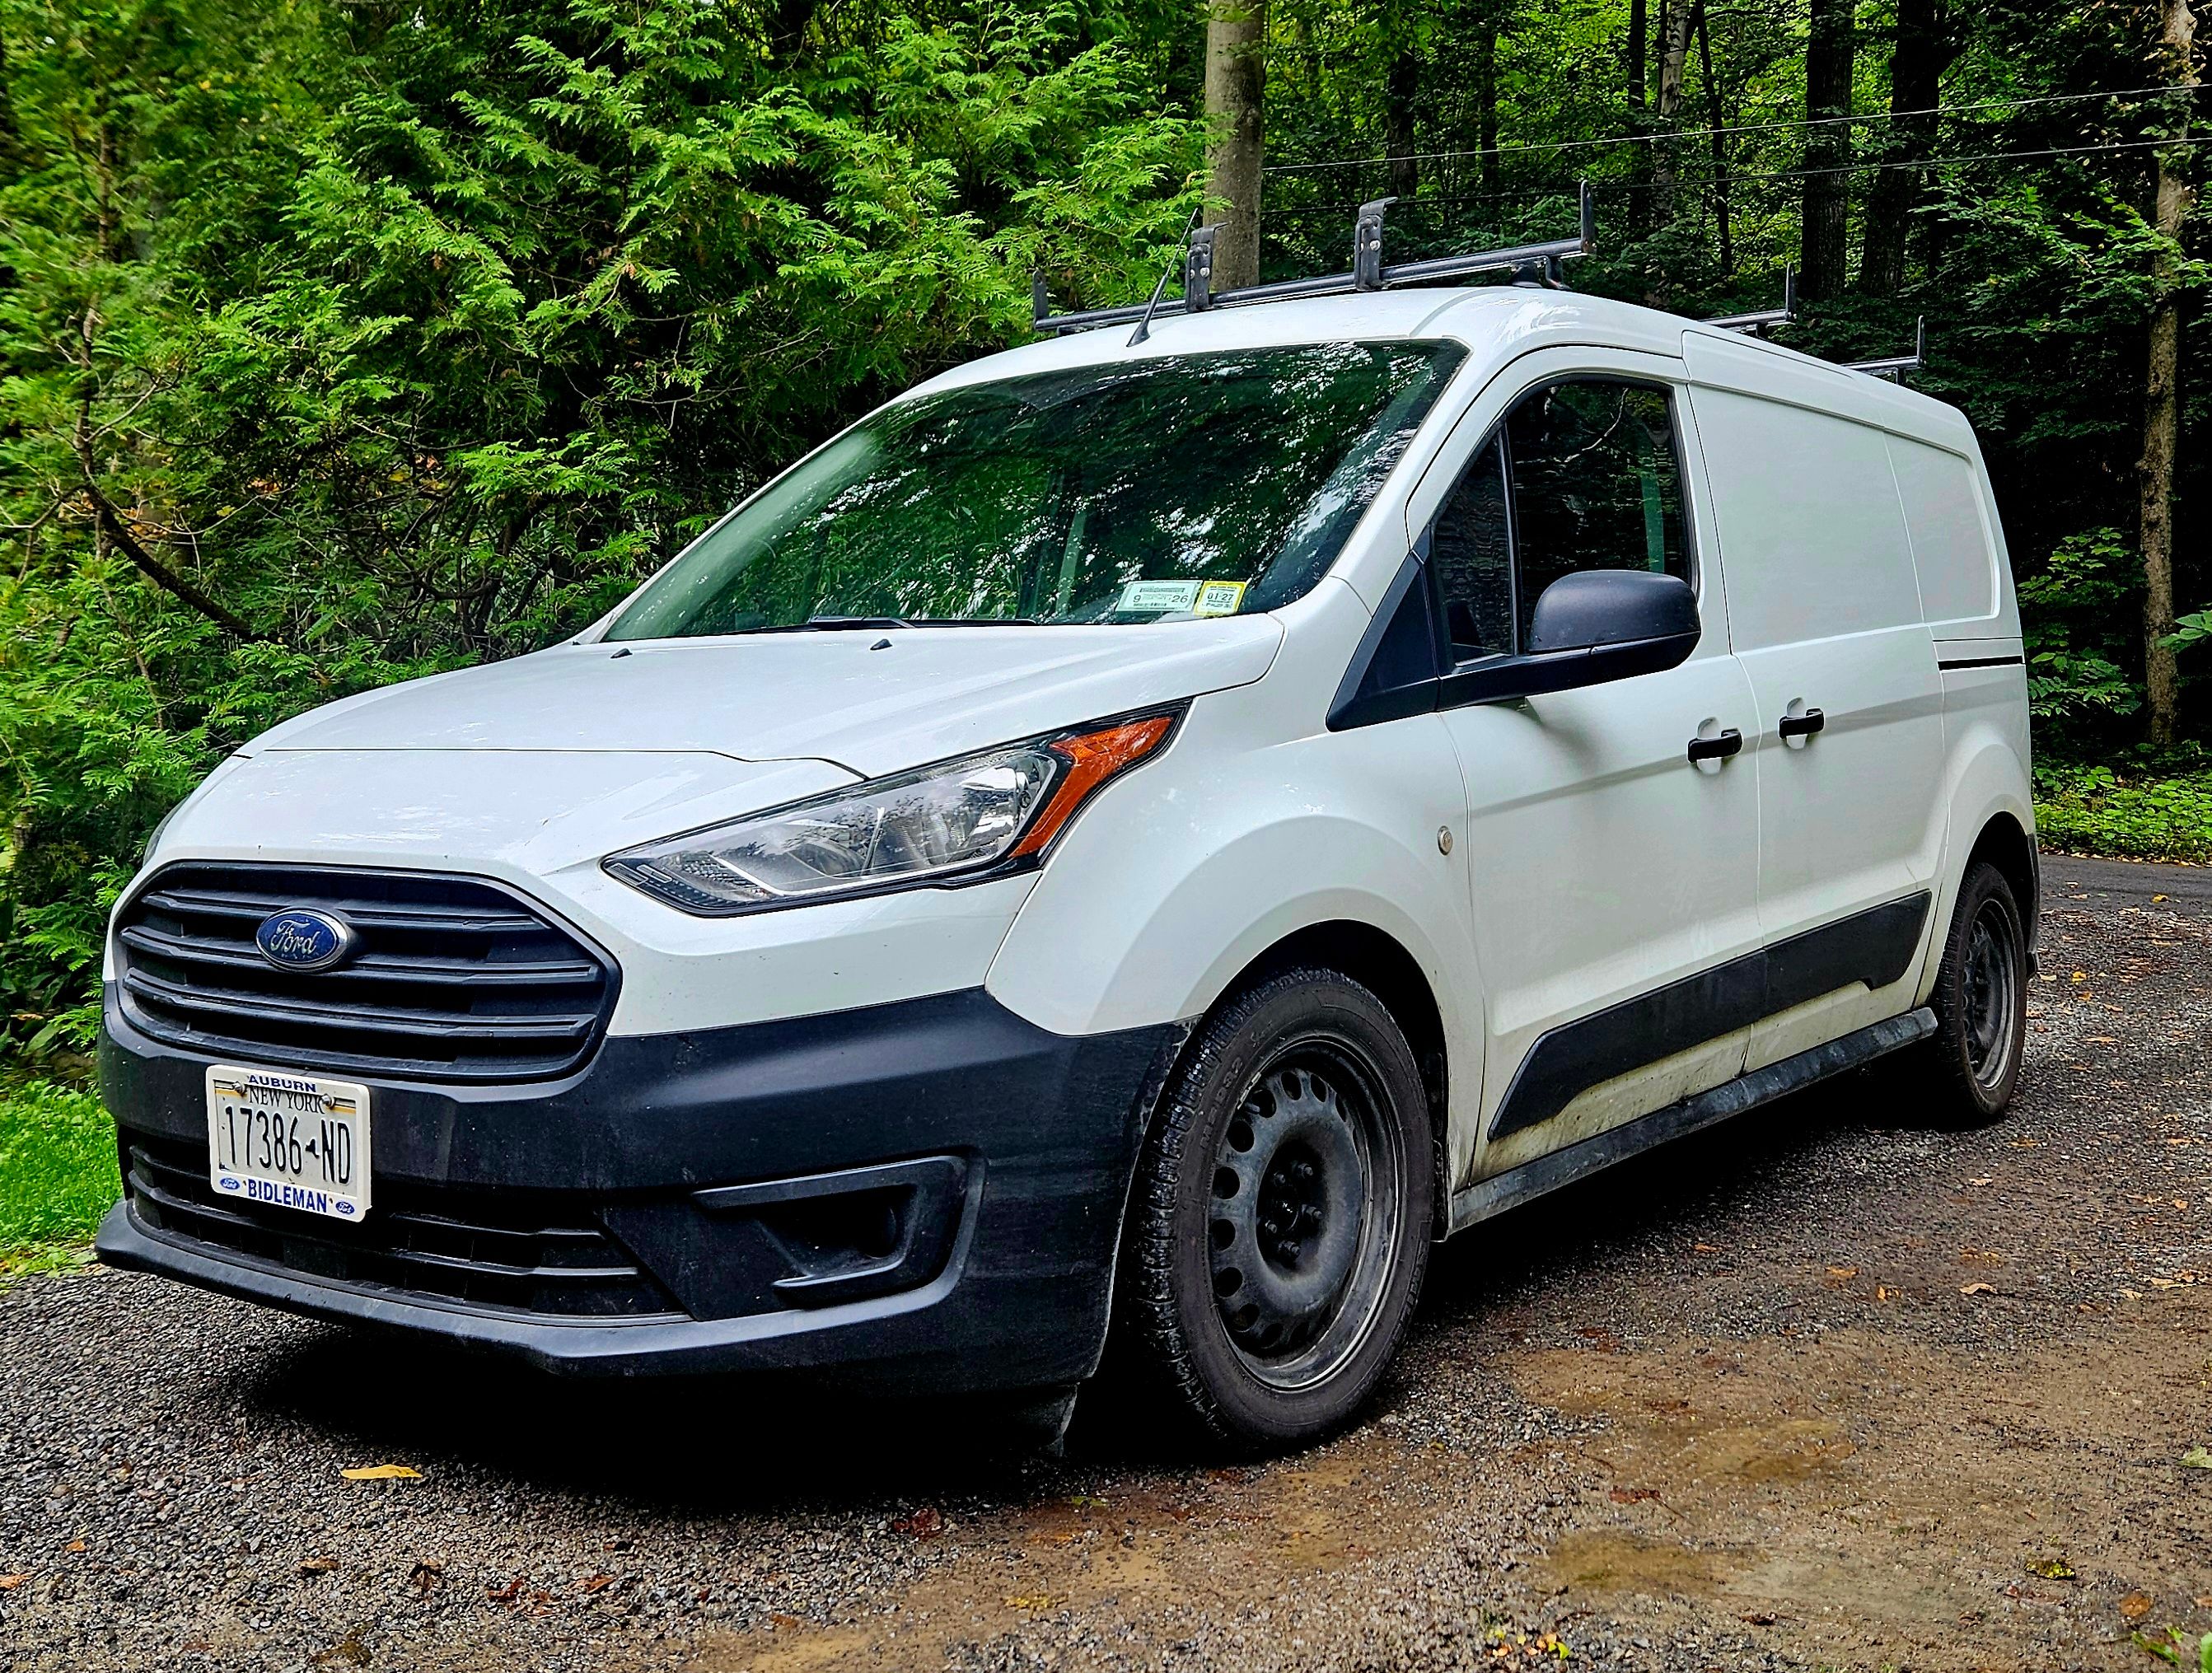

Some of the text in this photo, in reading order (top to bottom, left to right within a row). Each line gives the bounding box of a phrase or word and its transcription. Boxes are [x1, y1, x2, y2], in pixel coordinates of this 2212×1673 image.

[1133, 595, 1142, 603] 9
[1171, 595, 1189, 603] 26
[269, 918, 321, 955] Ford
[248, 1074, 317, 1093] AUBURN
[249, 1086, 325, 1115] NEW YORK
[224, 1105, 352, 1185] 17386 ND
[221, 1178, 241, 1190] Ford
[248, 1178, 328, 1213] BIDLEMAN
